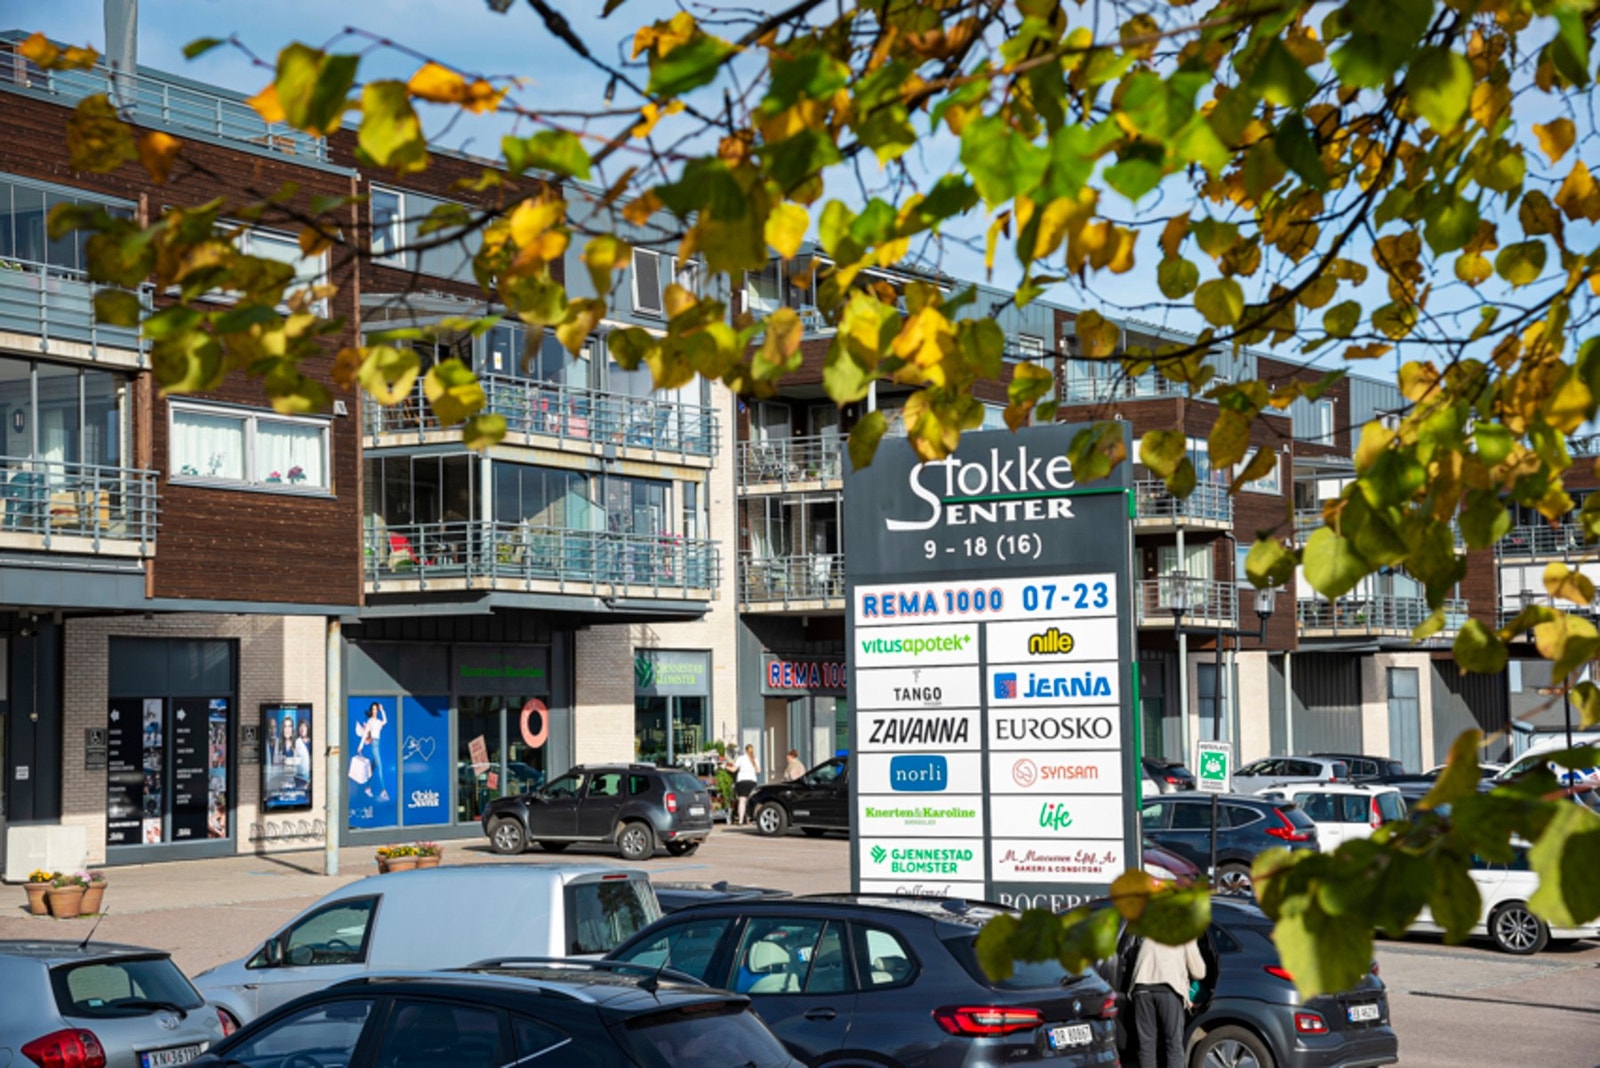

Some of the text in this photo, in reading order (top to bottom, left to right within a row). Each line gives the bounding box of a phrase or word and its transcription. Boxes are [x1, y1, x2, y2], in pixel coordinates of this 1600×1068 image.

[885, 446, 1076, 531] Stokke
[924, 540, 937, 559] 9
[964, 537, 987, 557] 18
[996, 532, 1042, 561] (16)
[862, 581, 1109, 619] REMA 1000 07-23
[1028, 627, 1075, 655] nille
[768, 660, 848, 689] REMA 100
[893, 686, 942, 702] TANGO
[868, 717, 969, 745] ZAVANNA
[995, 717, 1113, 740] EUROSKO
[895, 762, 942, 783] norli
[1040, 765, 1099, 779] SYNSAM
[1039, 802, 1073, 831] life
[891, 848, 974, 861] GJENNESTAD
[891, 861, 958, 874] BLOMSTER
[152, 1052, 167, 1067] XN
